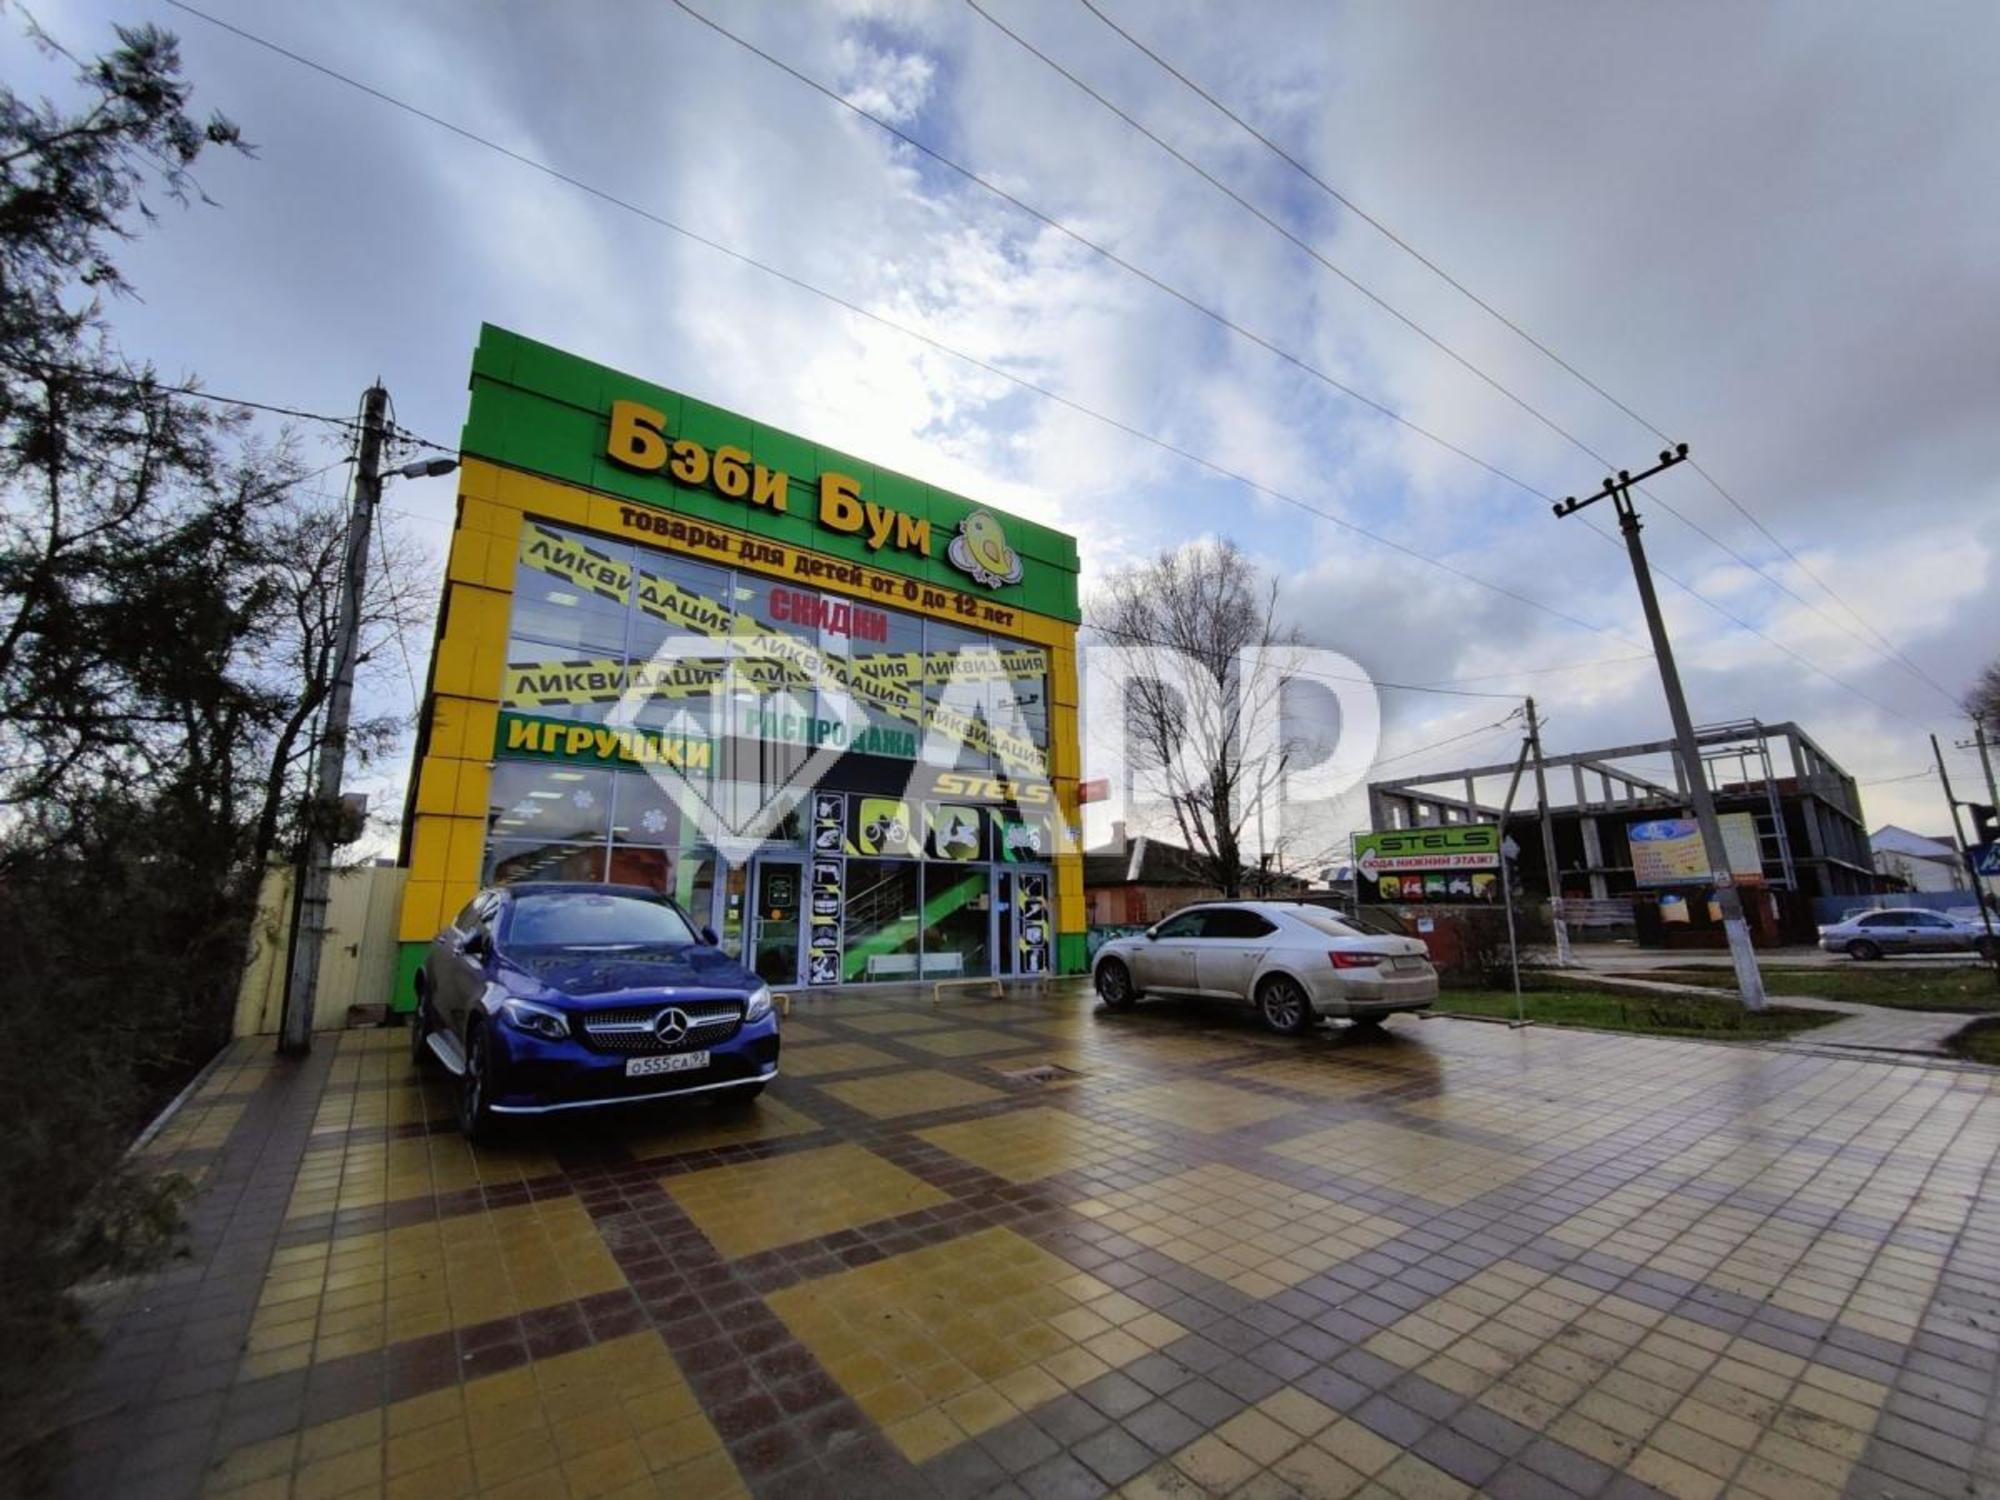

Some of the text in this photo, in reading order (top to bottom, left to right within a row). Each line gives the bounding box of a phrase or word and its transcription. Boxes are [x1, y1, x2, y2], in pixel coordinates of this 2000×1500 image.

[608, 400, 931, 555] Бэби Бум
[529, 541, 731, 632] ЛИКВИДАЦИЯ
[620, 507, 729, 551] товары
[738, 540, 786, 566] для
[794, 554, 863, 587] детей
[870, 575, 897, 594] от
[922, 589, 946, 609] до
[952, 594, 976, 617] 12
[983, 605, 1015, 626] лет
[769, 588, 887, 643] СКИДКИ
[516, 668, 726, 694] ЛИКВИДАЦИ
[925, 657, 1044, 676] ЛИКВИДАЦИЯ
[508, 720, 710, 768] ИГРУШКИ
[746, 710, 917, 757] РАСПРОДАЖА
[932, 772, 1051, 803] STELS
[1380, 832, 1490, 850] STELS
